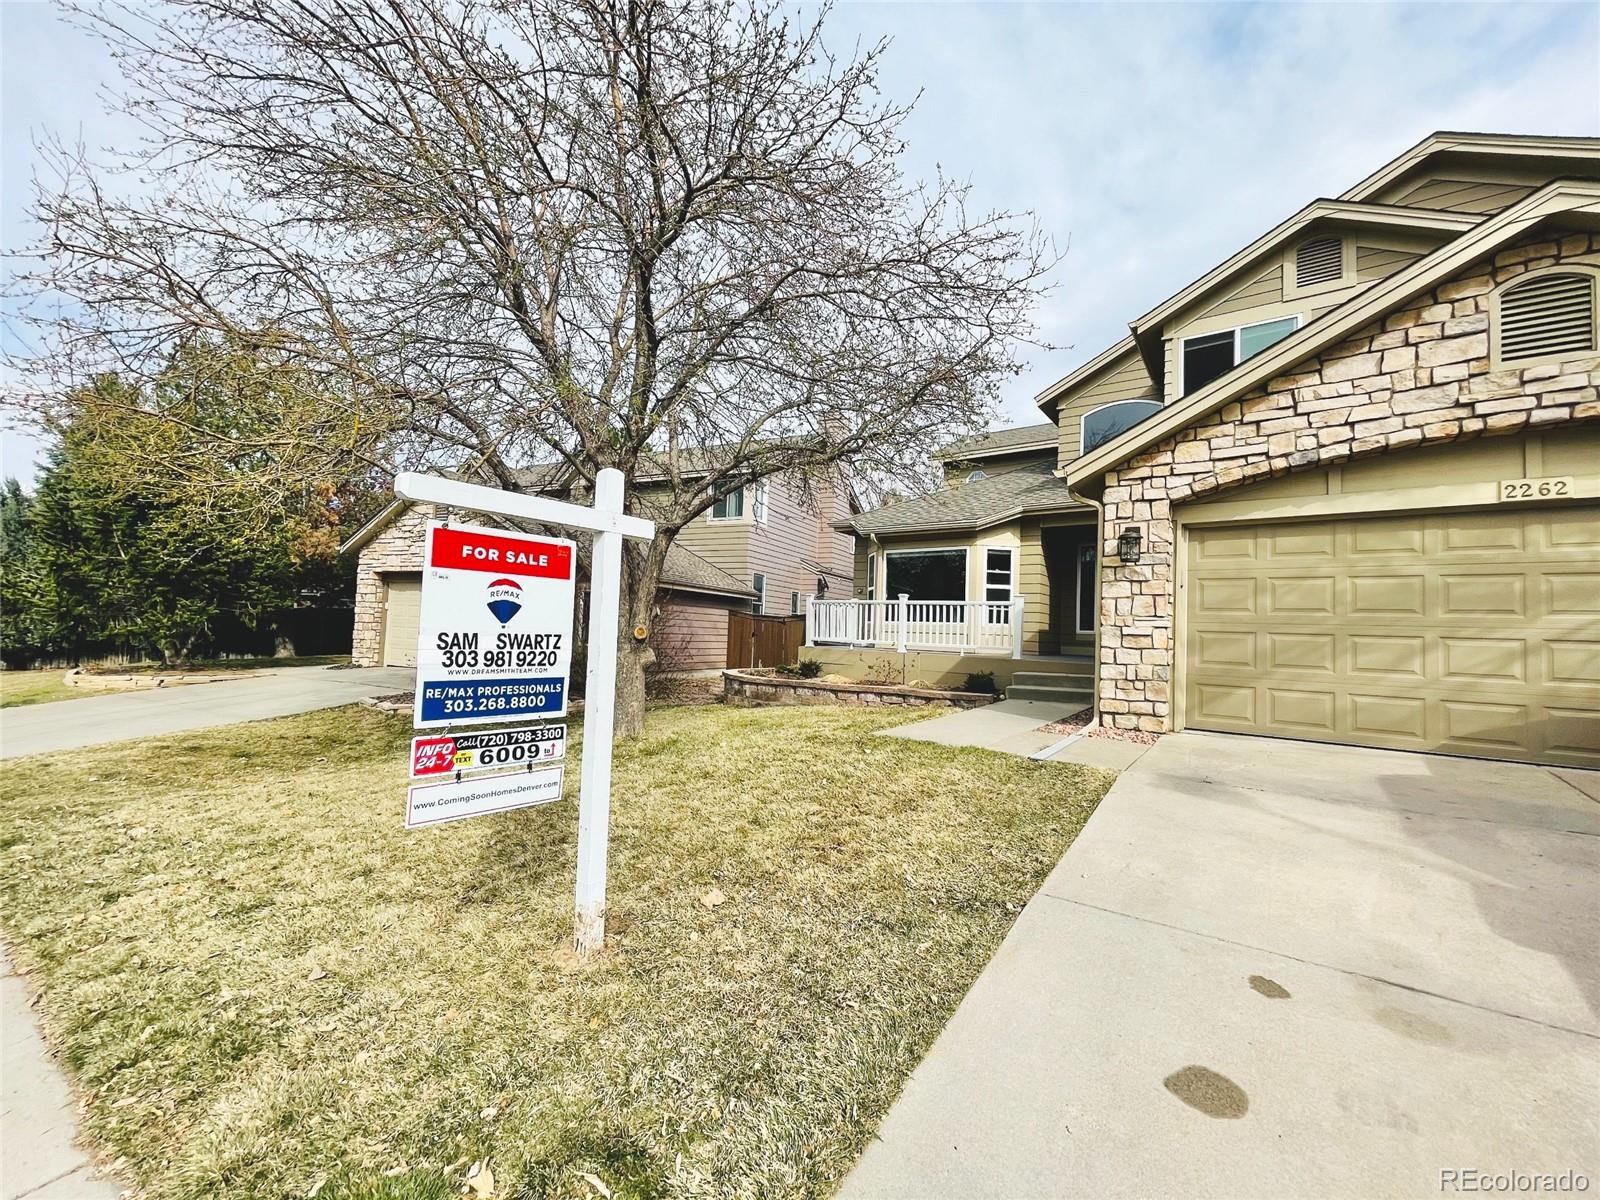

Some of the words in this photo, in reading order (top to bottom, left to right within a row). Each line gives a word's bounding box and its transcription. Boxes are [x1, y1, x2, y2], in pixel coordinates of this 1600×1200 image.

[1504, 481, 1568, 498] 2262
[462, 545, 499, 562] FOR
[505, 550, 549, 567] SALE
[490, 589, 520, 600] RE/MAX
[436, 632, 479, 650] SAM
[496, 633, 562, 650] SWARTZ
[441, 650, 479, 668] 303
[483, 650, 512, 667] 981
[516, 650, 557, 667] 9220
[447, 667, 548, 675] WWW.DREAMSMITHTEAM.COM
[425, 687, 474, 699] RE/MAX
[477, 683, 562, 696] PROFESSIONALS
[444, 695, 546, 713] 303.268.8800
[456, 737, 477, 748] Call
[477, 734, 508, 747] (720)
[510, 728, 562, 744] 798-3300
[416, 743, 453, 758] INFO
[479, 743, 540, 765] 6009
[415, 755, 453, 770] 24-7
[455, 755, 472, 764] TEXT
[413, 780, 559, 811] www.ComingSoonHomesDenver.com
